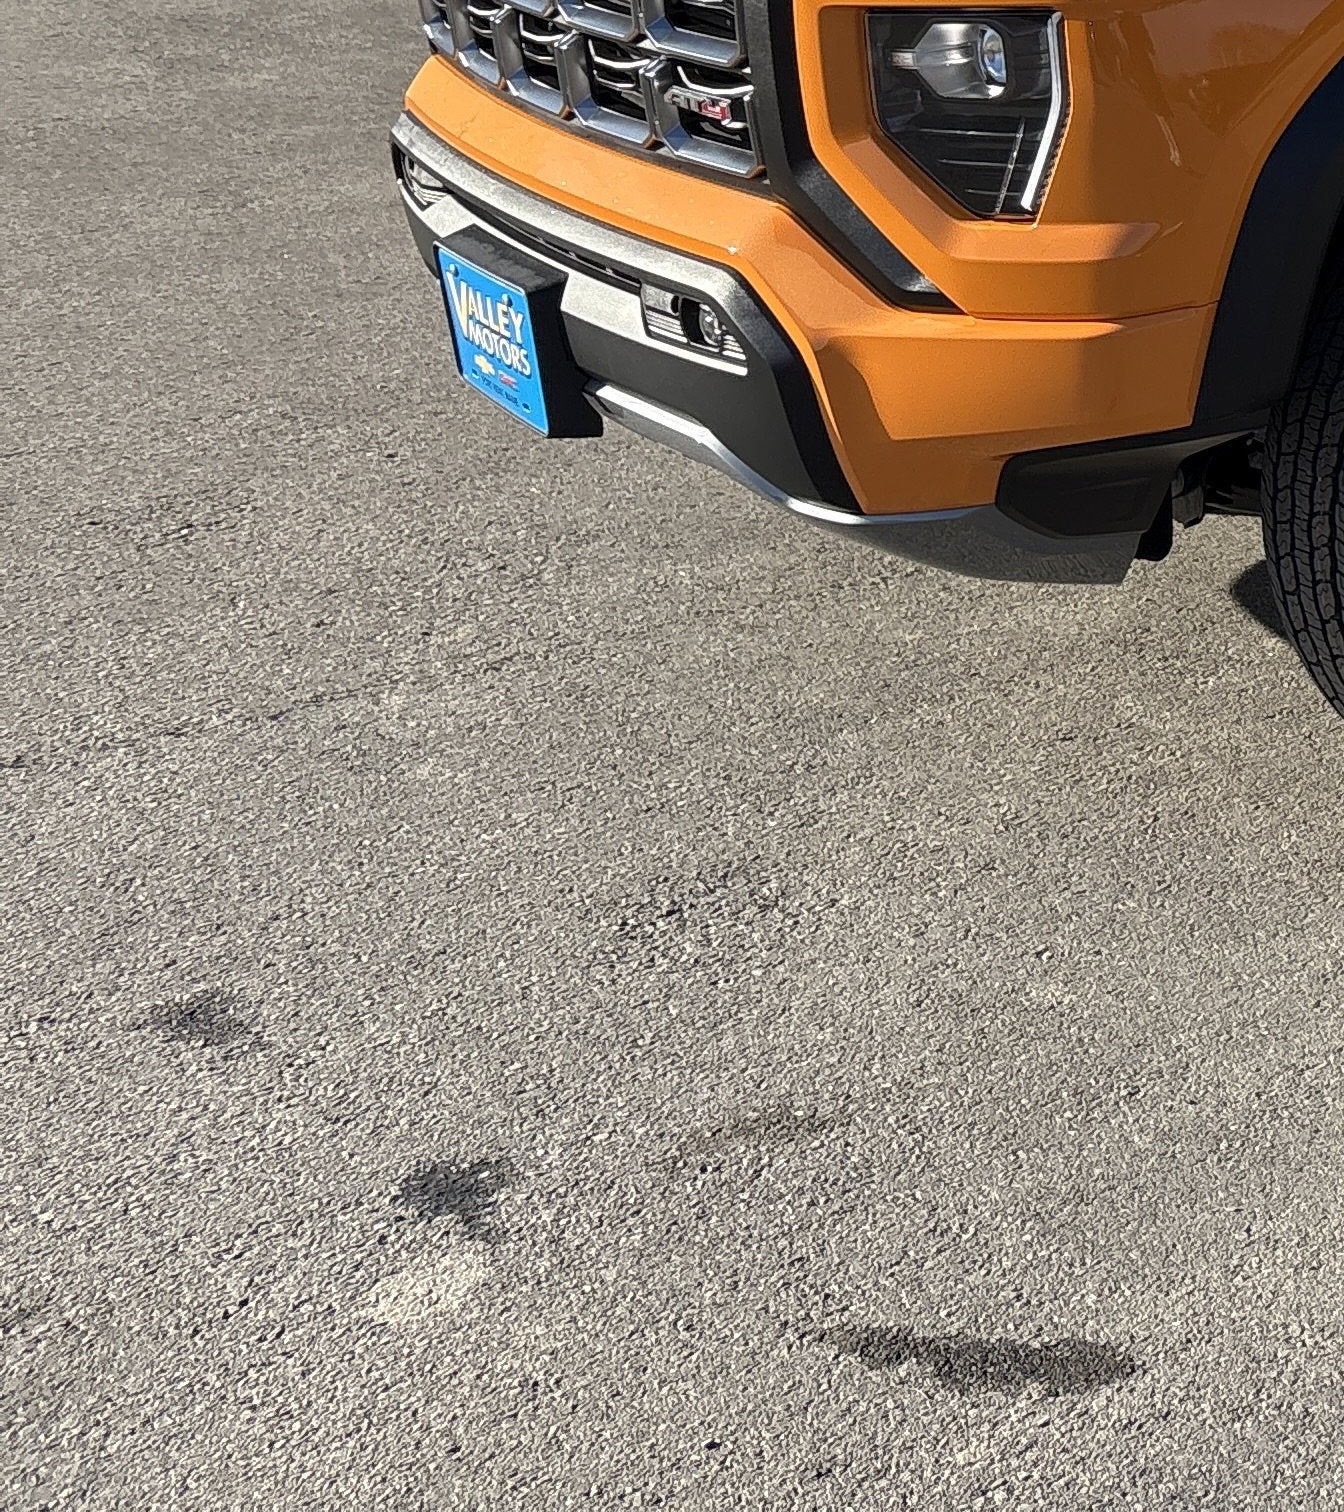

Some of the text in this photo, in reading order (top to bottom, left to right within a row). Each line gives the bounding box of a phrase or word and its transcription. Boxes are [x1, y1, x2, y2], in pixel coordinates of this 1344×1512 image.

[663, 84, 733, 126] AT4
[445, 271, 525, 345] VALLEY
[468, 318, 532, 377] MOTORS
